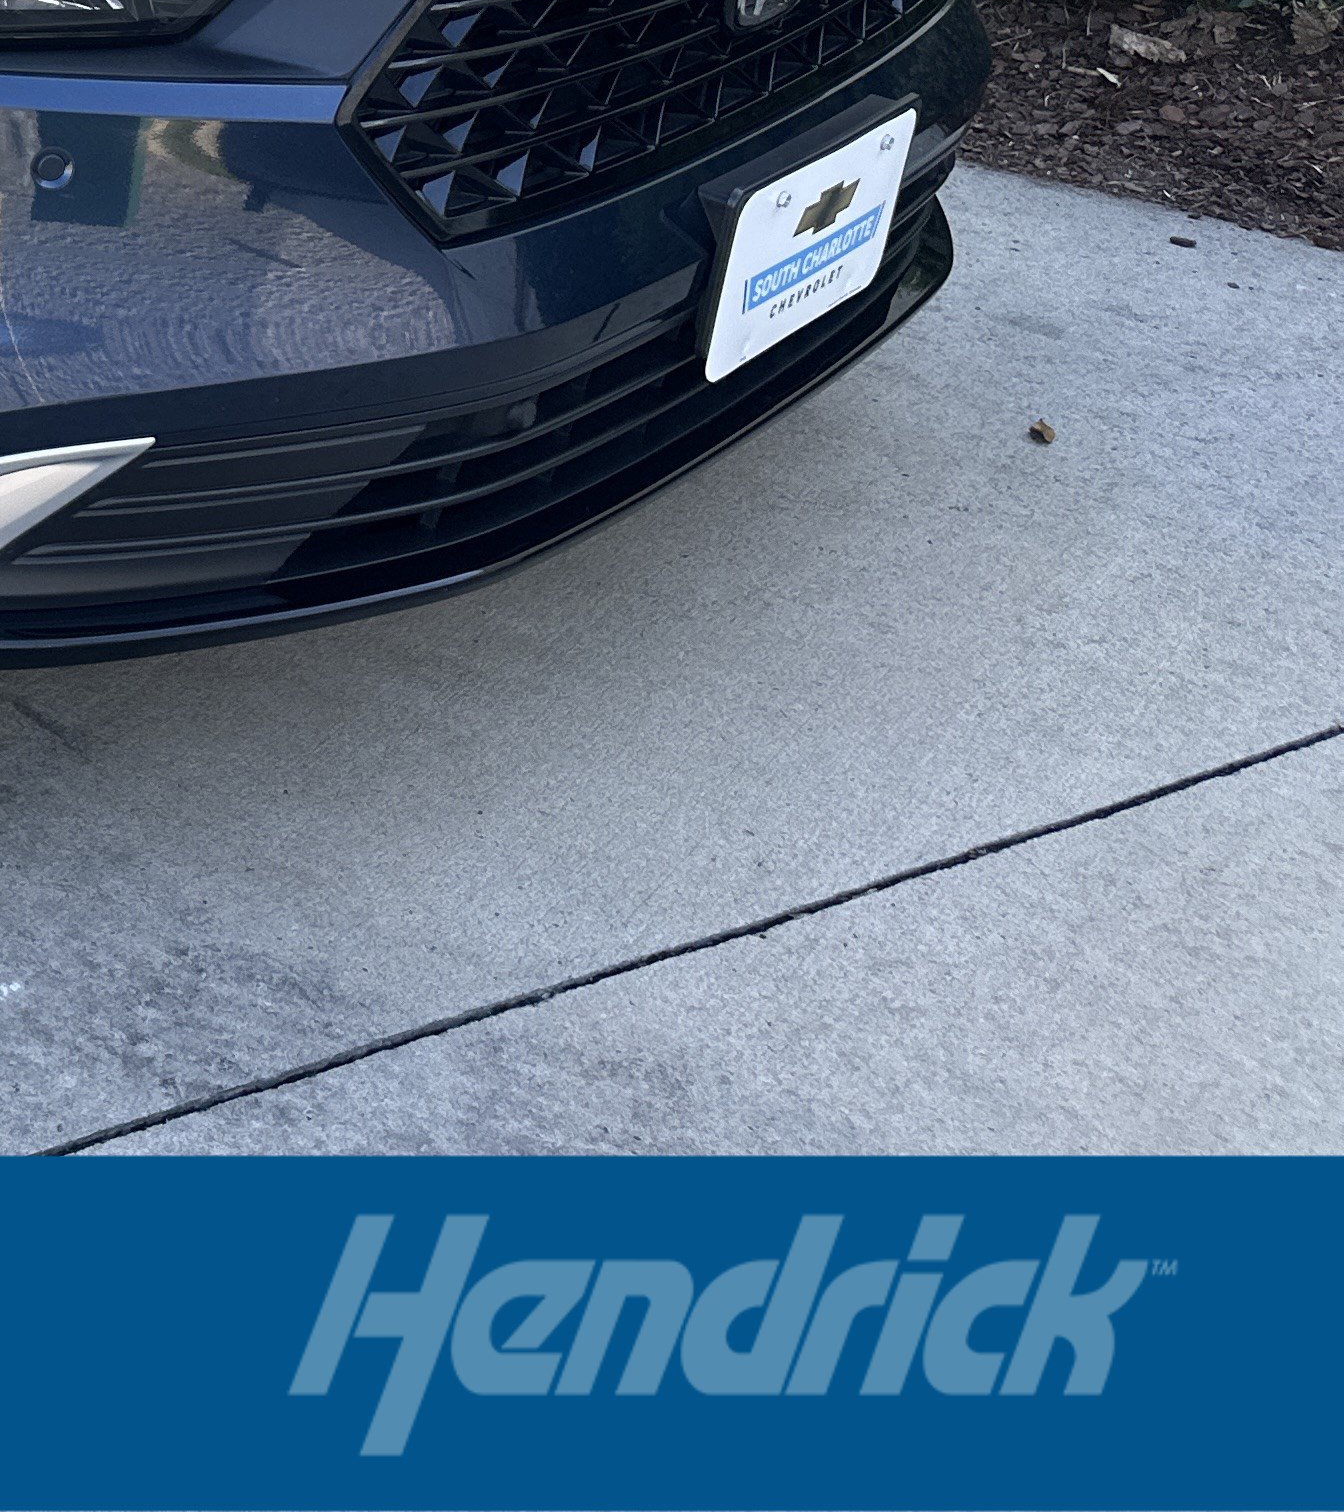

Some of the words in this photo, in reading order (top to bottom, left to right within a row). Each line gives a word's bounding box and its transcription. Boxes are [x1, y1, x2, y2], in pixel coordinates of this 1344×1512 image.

[752, 257, 802, 303] SOUTH
[801, 215, 875, 275] CHARLOTTE
[769, 264, 844, 319] CHEVROLET
